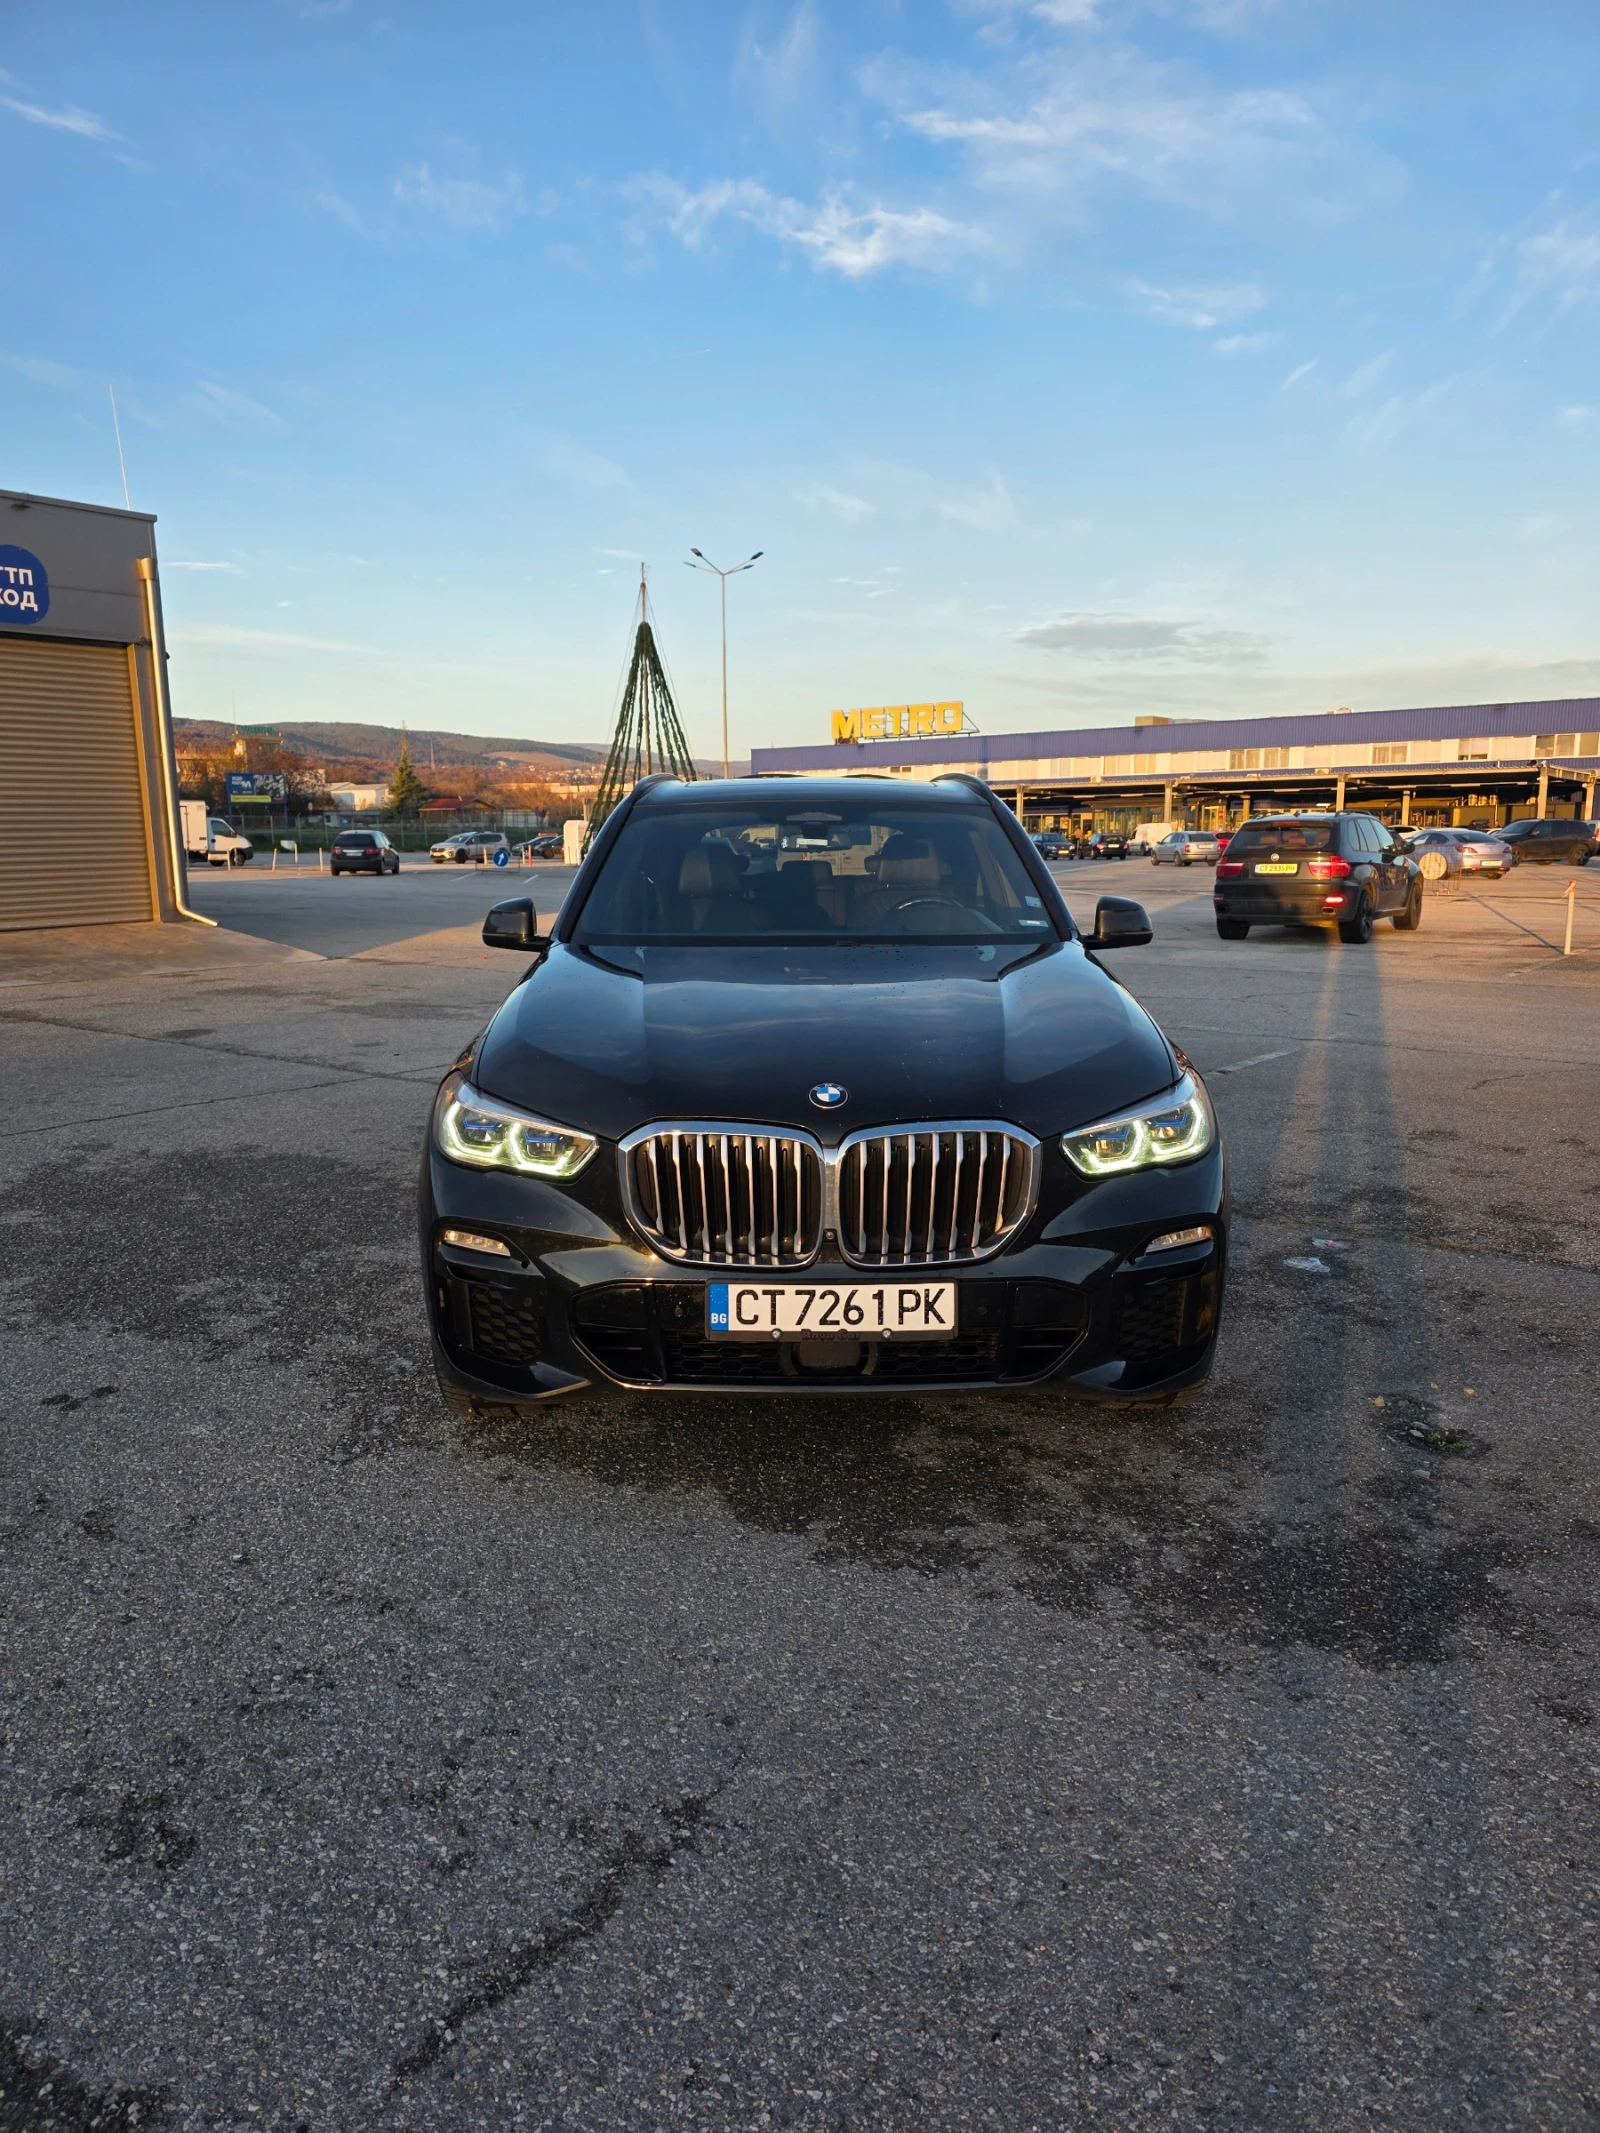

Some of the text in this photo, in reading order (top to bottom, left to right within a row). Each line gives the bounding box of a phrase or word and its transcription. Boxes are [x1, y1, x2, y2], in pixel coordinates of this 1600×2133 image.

[0, 566, 33, 586] ТП
[831, 701, 963, 739] METRO
[711, 1313, 727, 1324] BG
